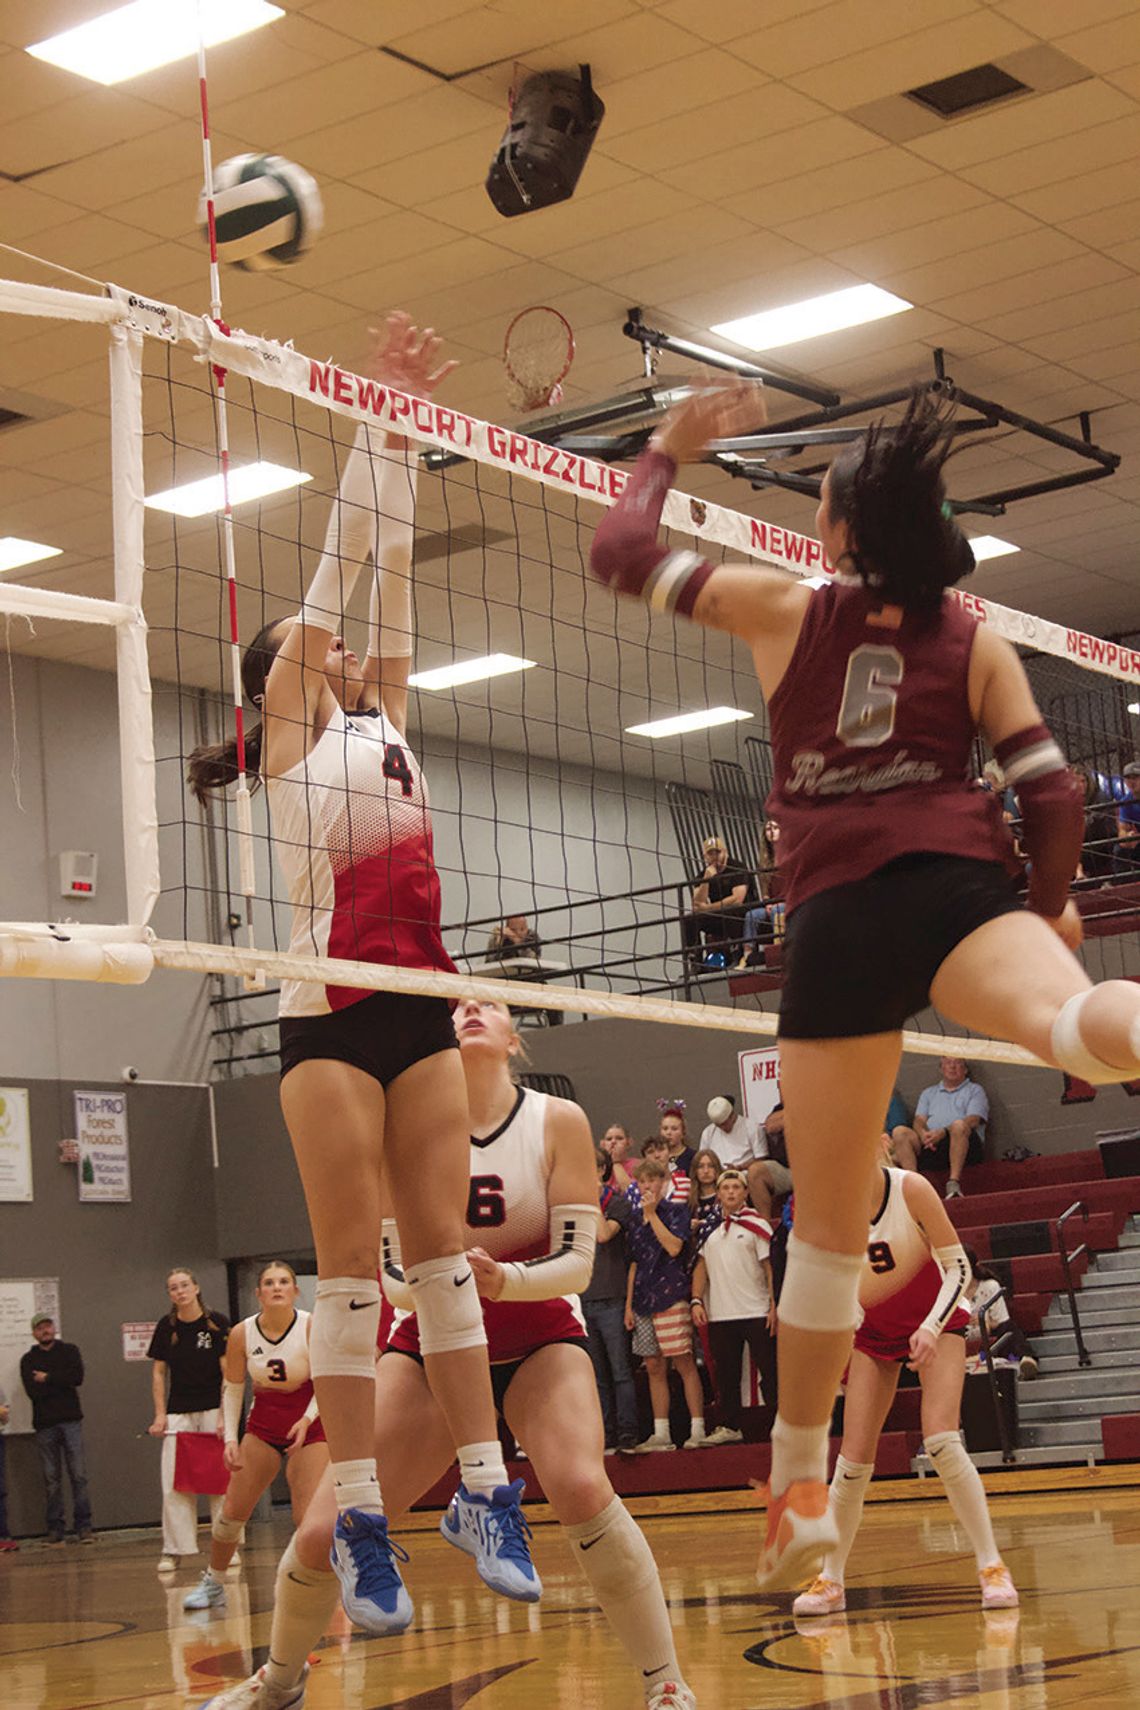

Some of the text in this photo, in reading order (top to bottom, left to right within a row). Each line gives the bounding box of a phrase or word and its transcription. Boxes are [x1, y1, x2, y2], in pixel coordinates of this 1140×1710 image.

[308, 360, 633, 500] NEWPORT GRIZZLIE
[835, 642, 904, 748] 6
[382, 743, 413, 797] 4
[752, 1060, 781, 1082] NH
[77, 1097, 124, 1114] TRI-PRO
[81, 1130, 124, 1145] Products
[466, 1174, 506, 1229] 6
[868, 1240, 896, 1274] 9
[266, 1358, 288, 1382] 3
